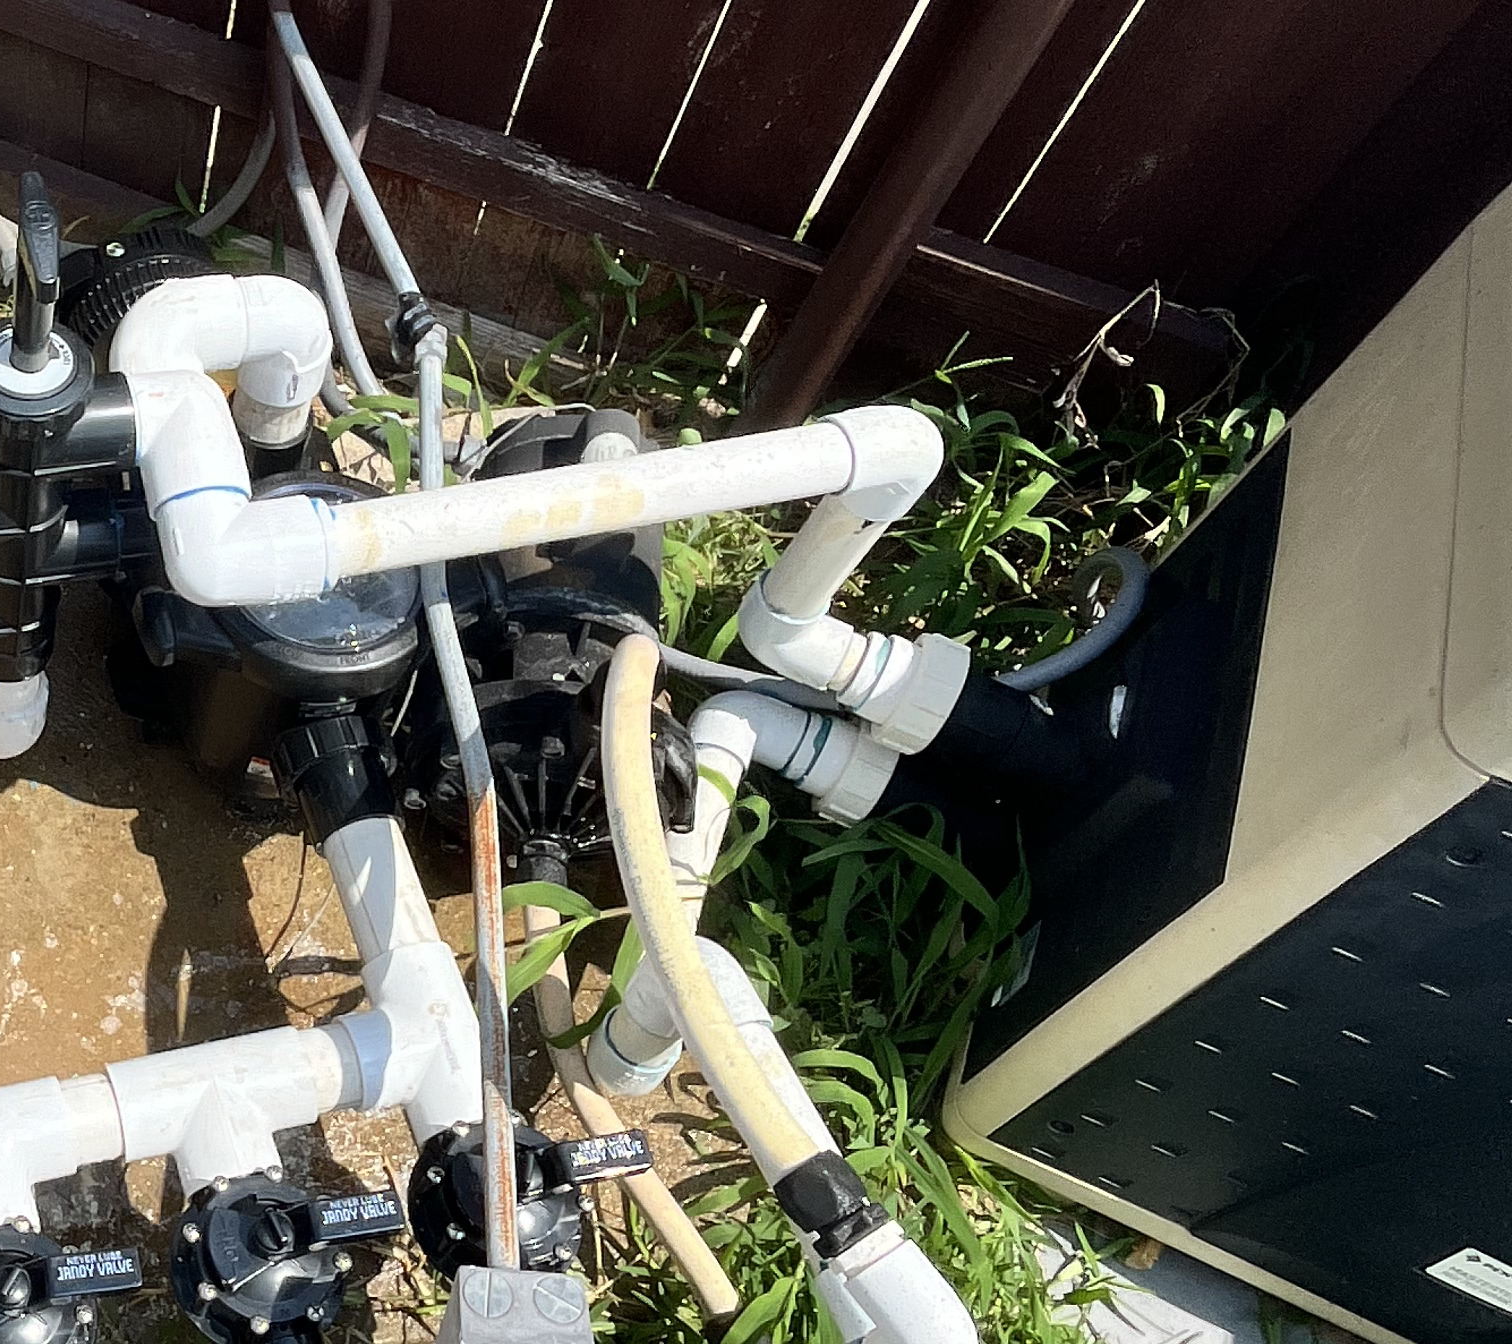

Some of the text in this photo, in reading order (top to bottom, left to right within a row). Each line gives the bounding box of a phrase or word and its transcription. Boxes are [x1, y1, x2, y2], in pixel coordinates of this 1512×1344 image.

[608, 1141, 644, 1160] VALVE
[322, 1201, 397, 1225] JANDY VALVE
[57, 1258, 134, 1281] JANDY VALVE
[67, 1254, 96, 1266] NEVER
